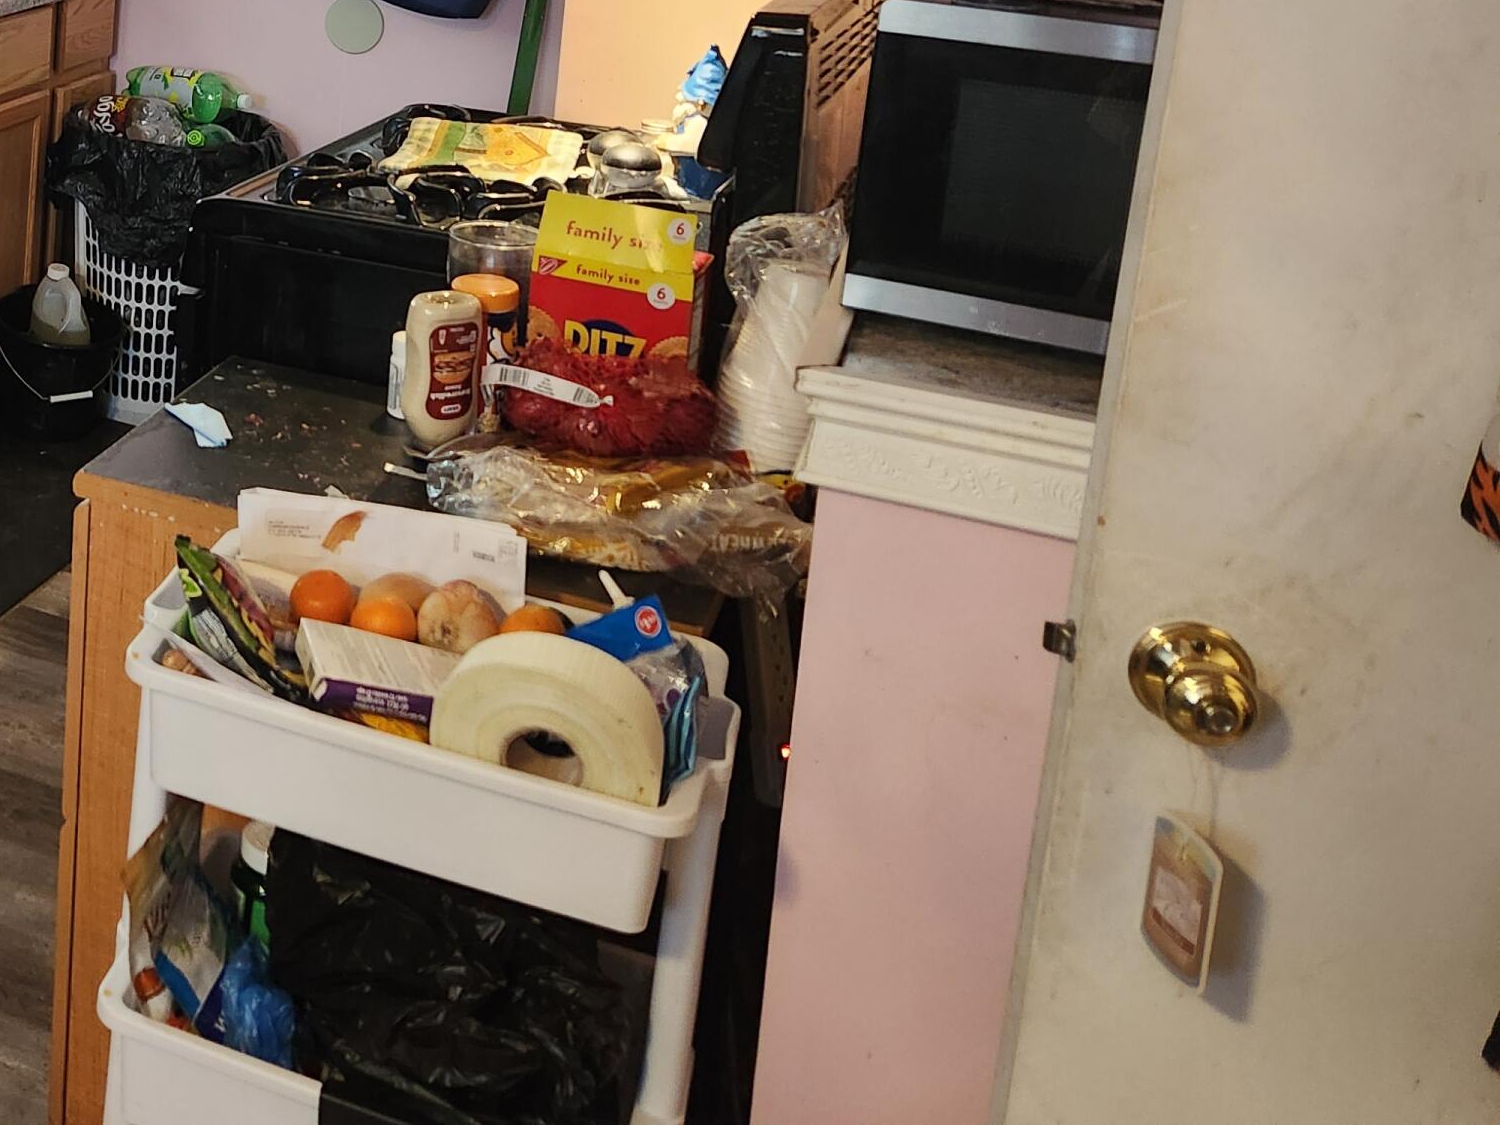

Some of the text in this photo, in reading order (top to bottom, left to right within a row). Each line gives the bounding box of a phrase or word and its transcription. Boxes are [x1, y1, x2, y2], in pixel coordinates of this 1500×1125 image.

[566, 220, 623, 249] family
[675, 222, 686, 236] 6
[576, 264, 641, 286] family size
[656, 287, 667, 300] 6
